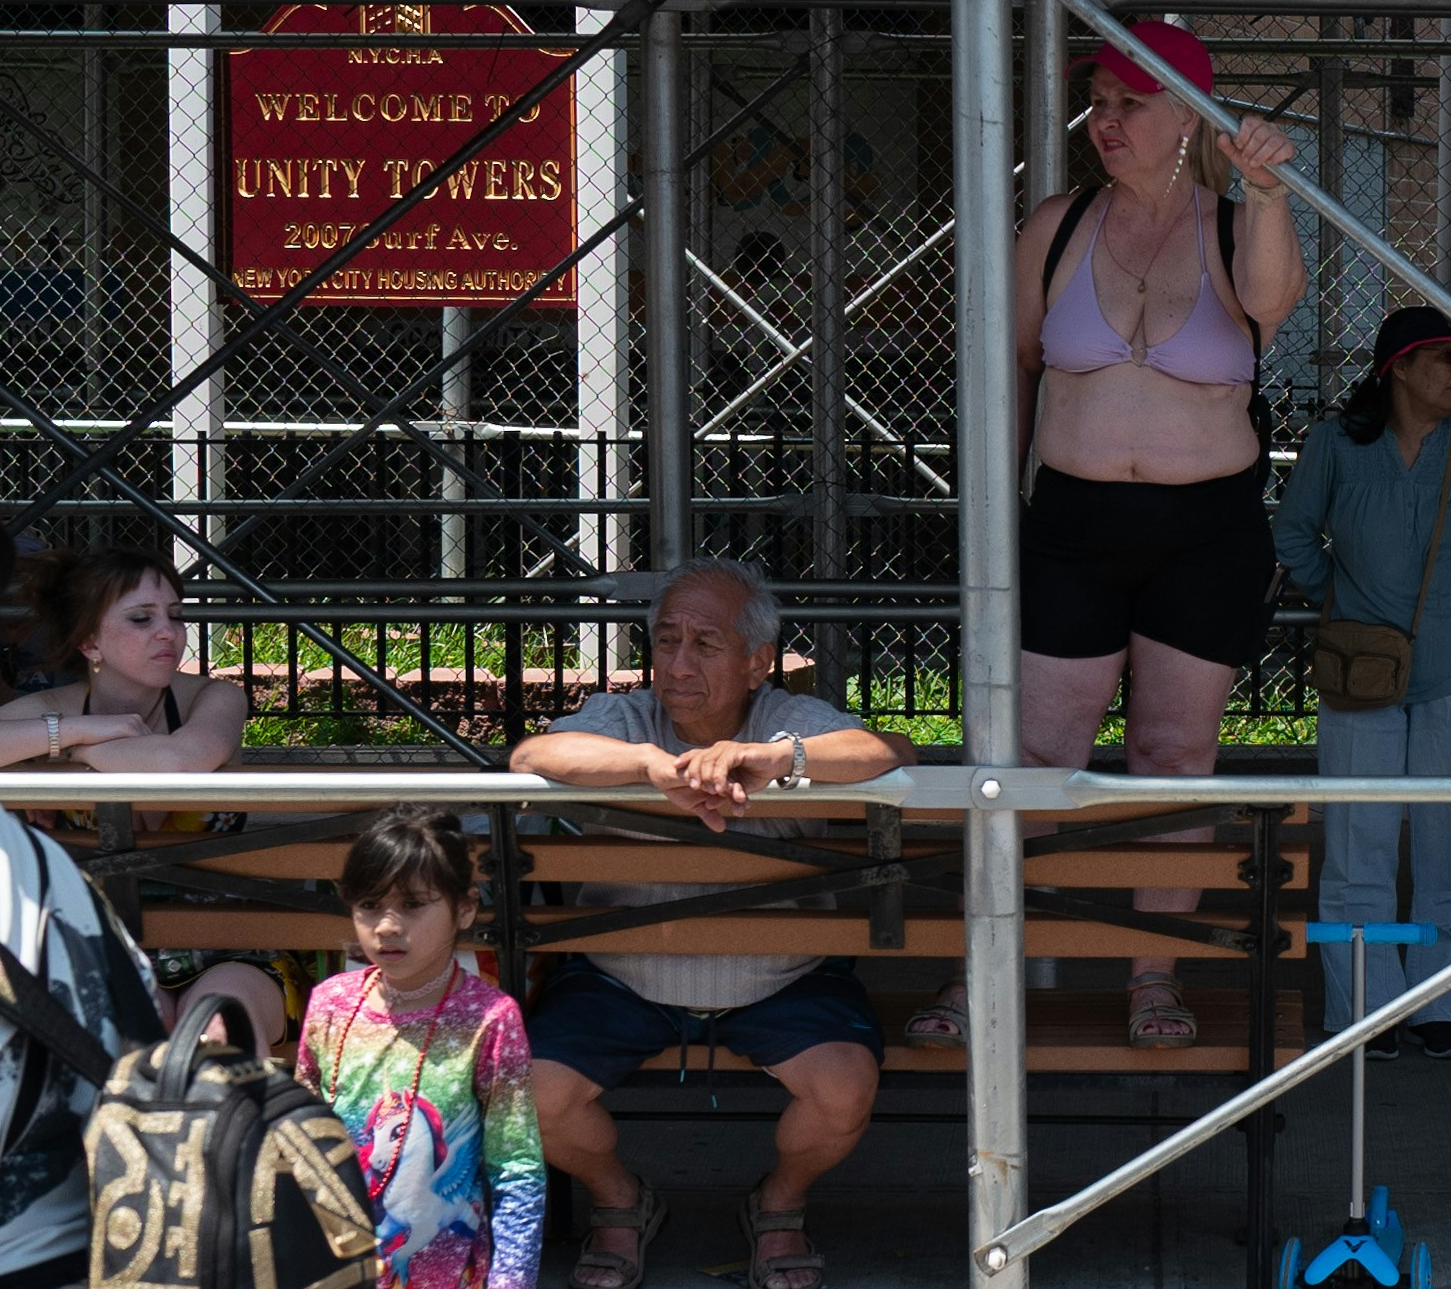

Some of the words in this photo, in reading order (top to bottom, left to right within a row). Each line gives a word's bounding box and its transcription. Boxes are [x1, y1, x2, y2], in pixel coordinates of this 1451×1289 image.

[254, 93, 474, 123] WELCOME
[234, 158, 367, 200] UNITY
[383, 158, 564, 202] TOWERS
[284, 222, 358, 250] 2007
[448, 223, 520, 251] Ave.
[232, 268, 274, 290] NEW
[330, 269, 373, 290] CITY
[377, 270, 458, 291] HOUSING
